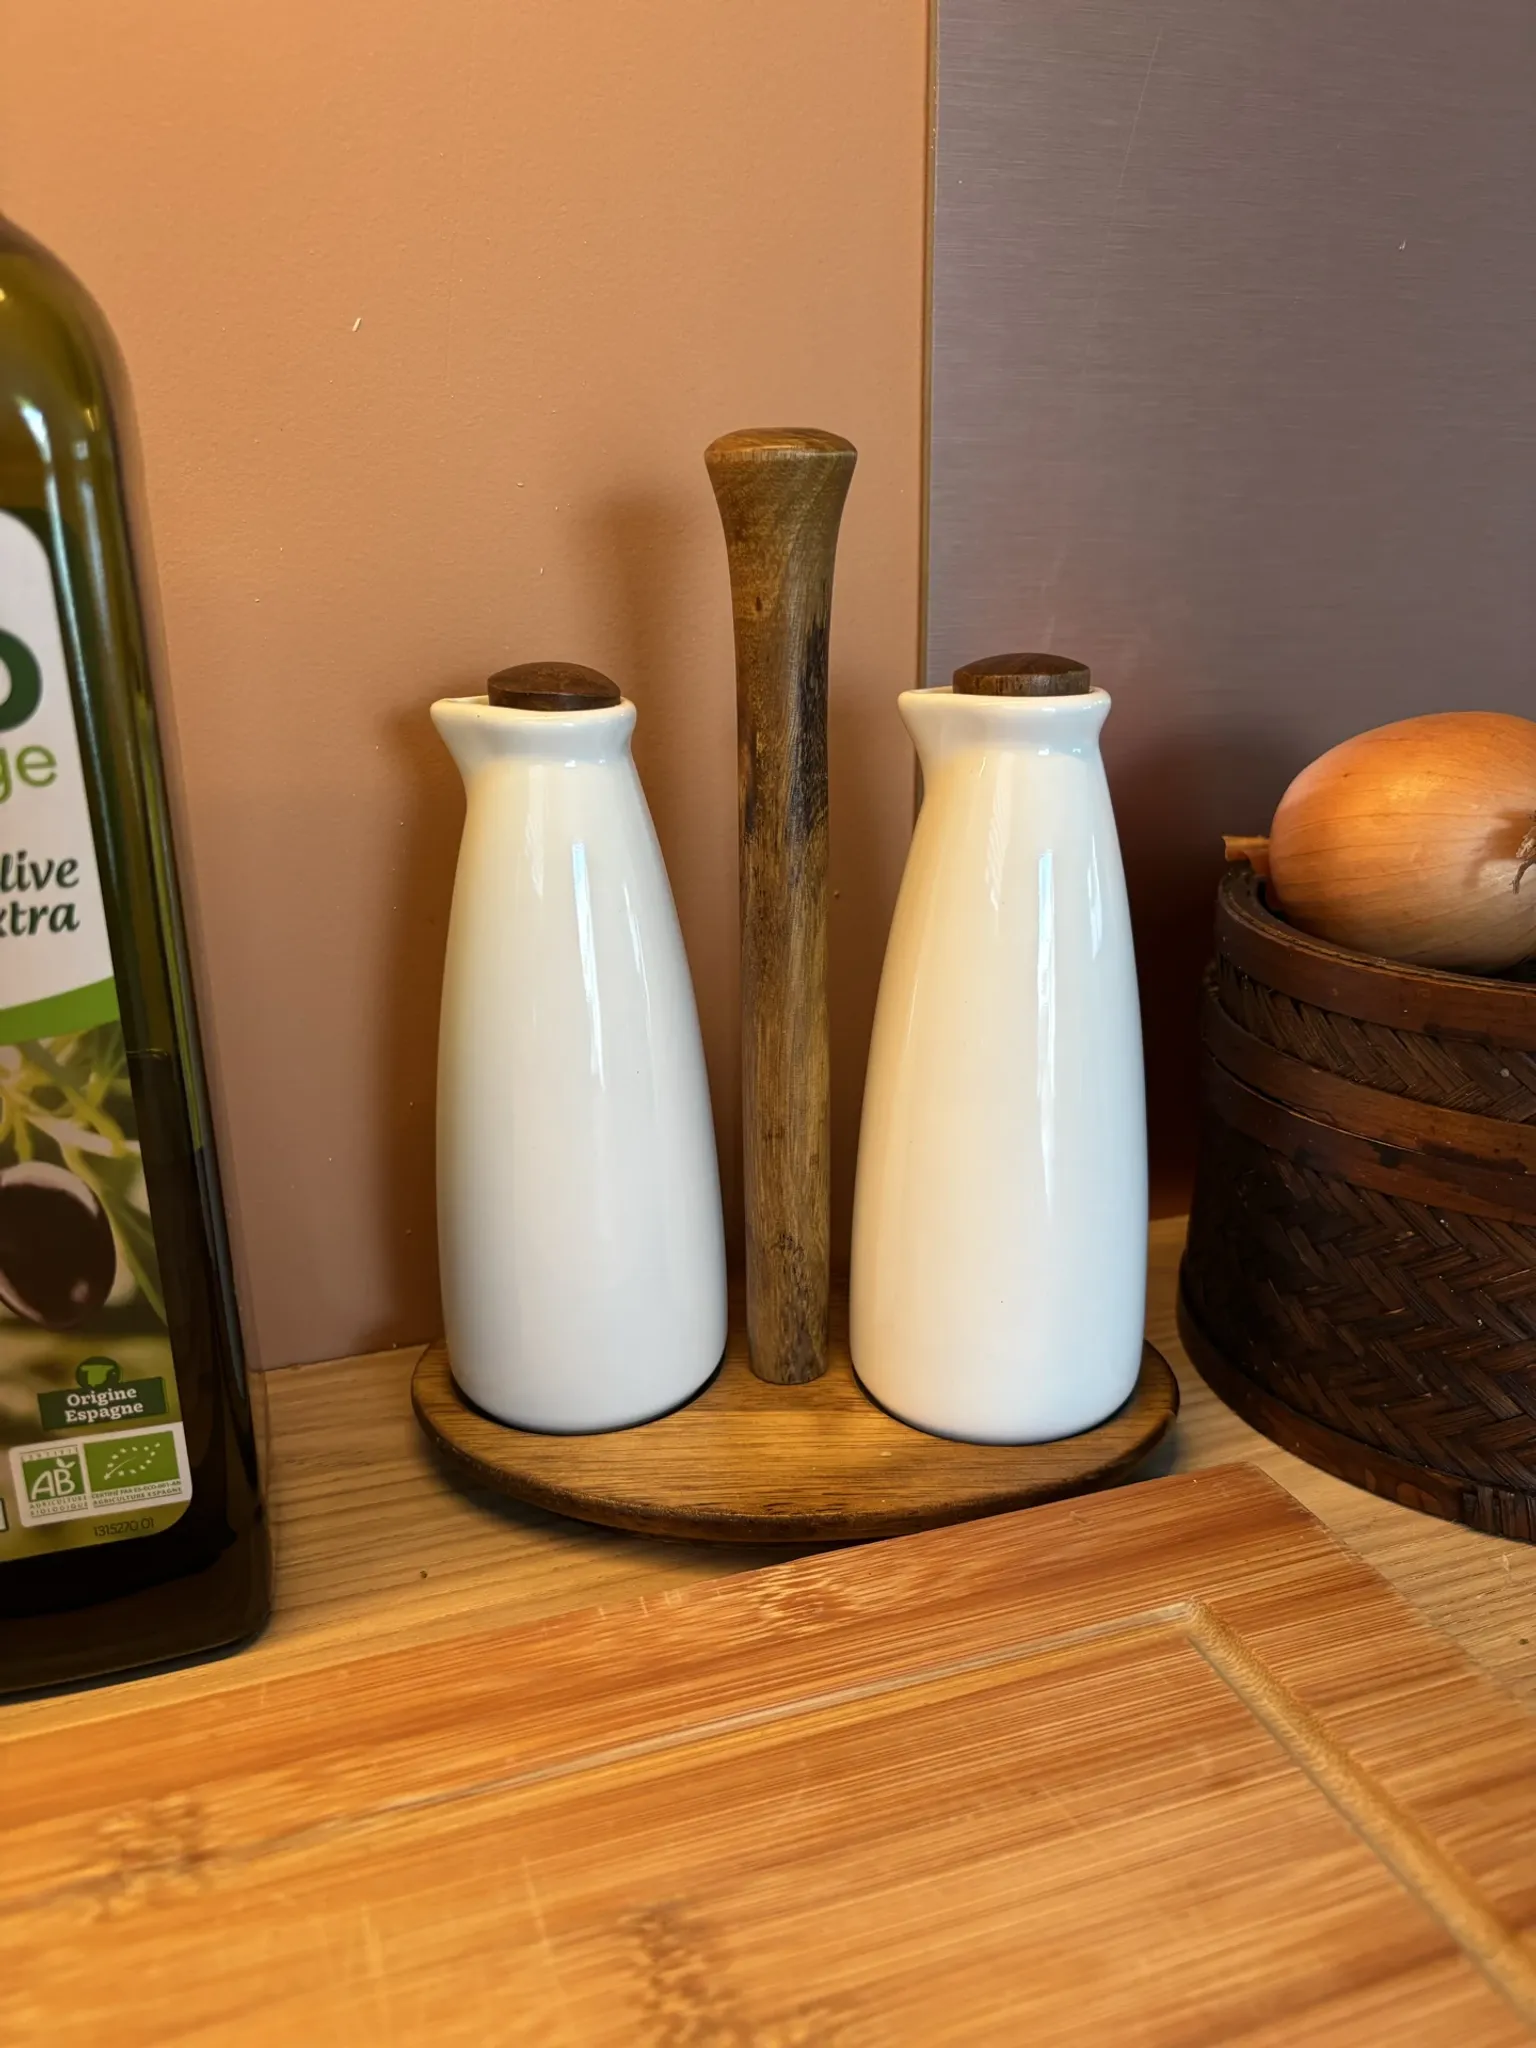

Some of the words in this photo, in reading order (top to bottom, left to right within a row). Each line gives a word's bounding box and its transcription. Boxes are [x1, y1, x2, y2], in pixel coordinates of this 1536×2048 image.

[66, 1387, 137, 1407] Origine
[64, 1401, 144, 1423] Espagne
[31, 1468, 76, 1500] AB
[94, 1520, 139, 1537] 1315270
